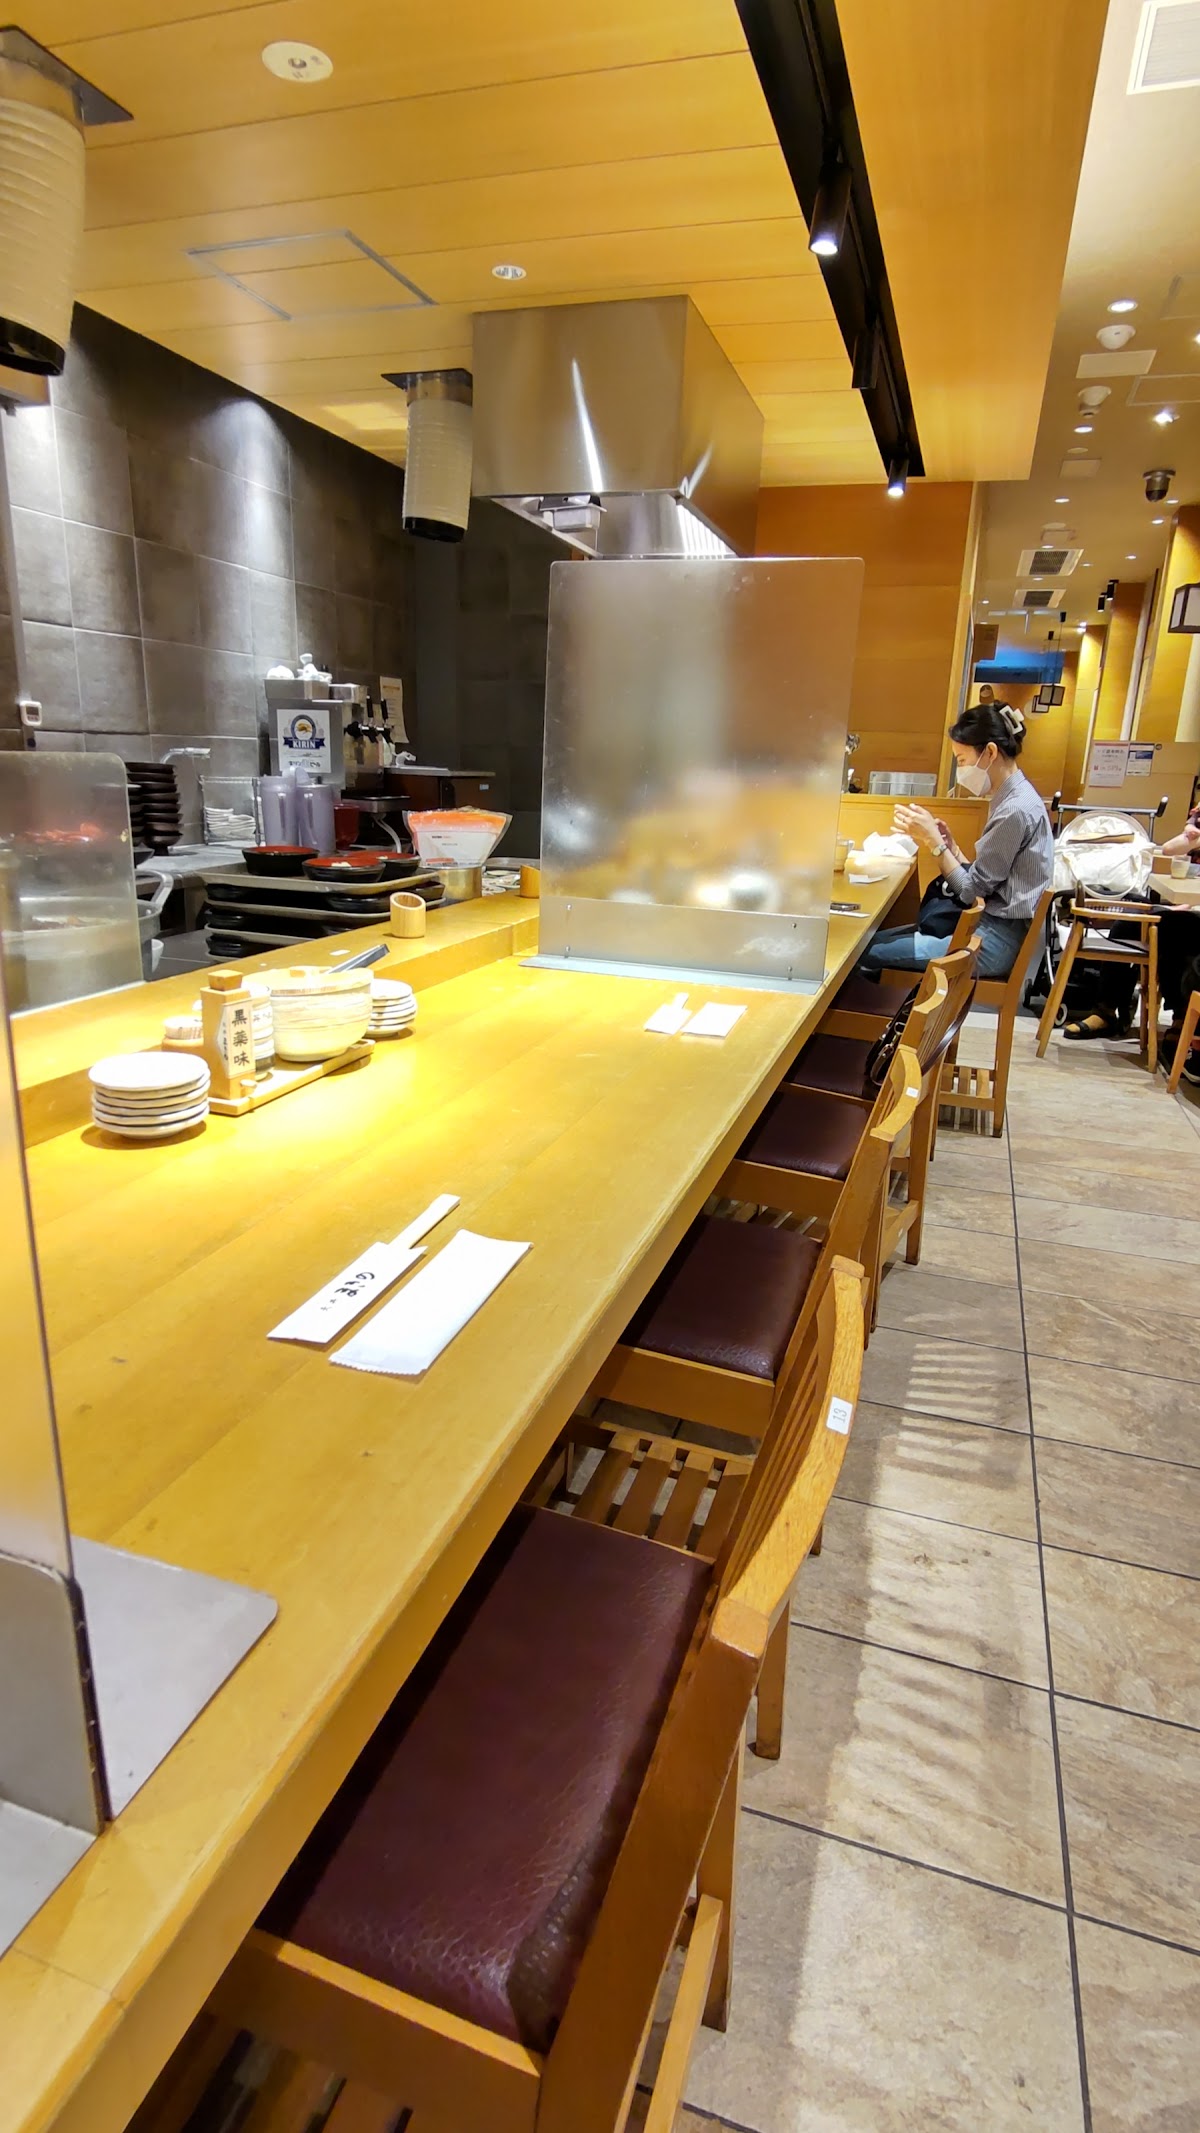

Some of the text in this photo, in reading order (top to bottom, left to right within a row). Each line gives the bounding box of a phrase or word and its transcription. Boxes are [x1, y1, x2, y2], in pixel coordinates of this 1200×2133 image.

[293, 740, 316, 749] KIRIN
[232, 1008, 251, 1067] 黒薬味
[832, 1407, 848, 1424] 13
